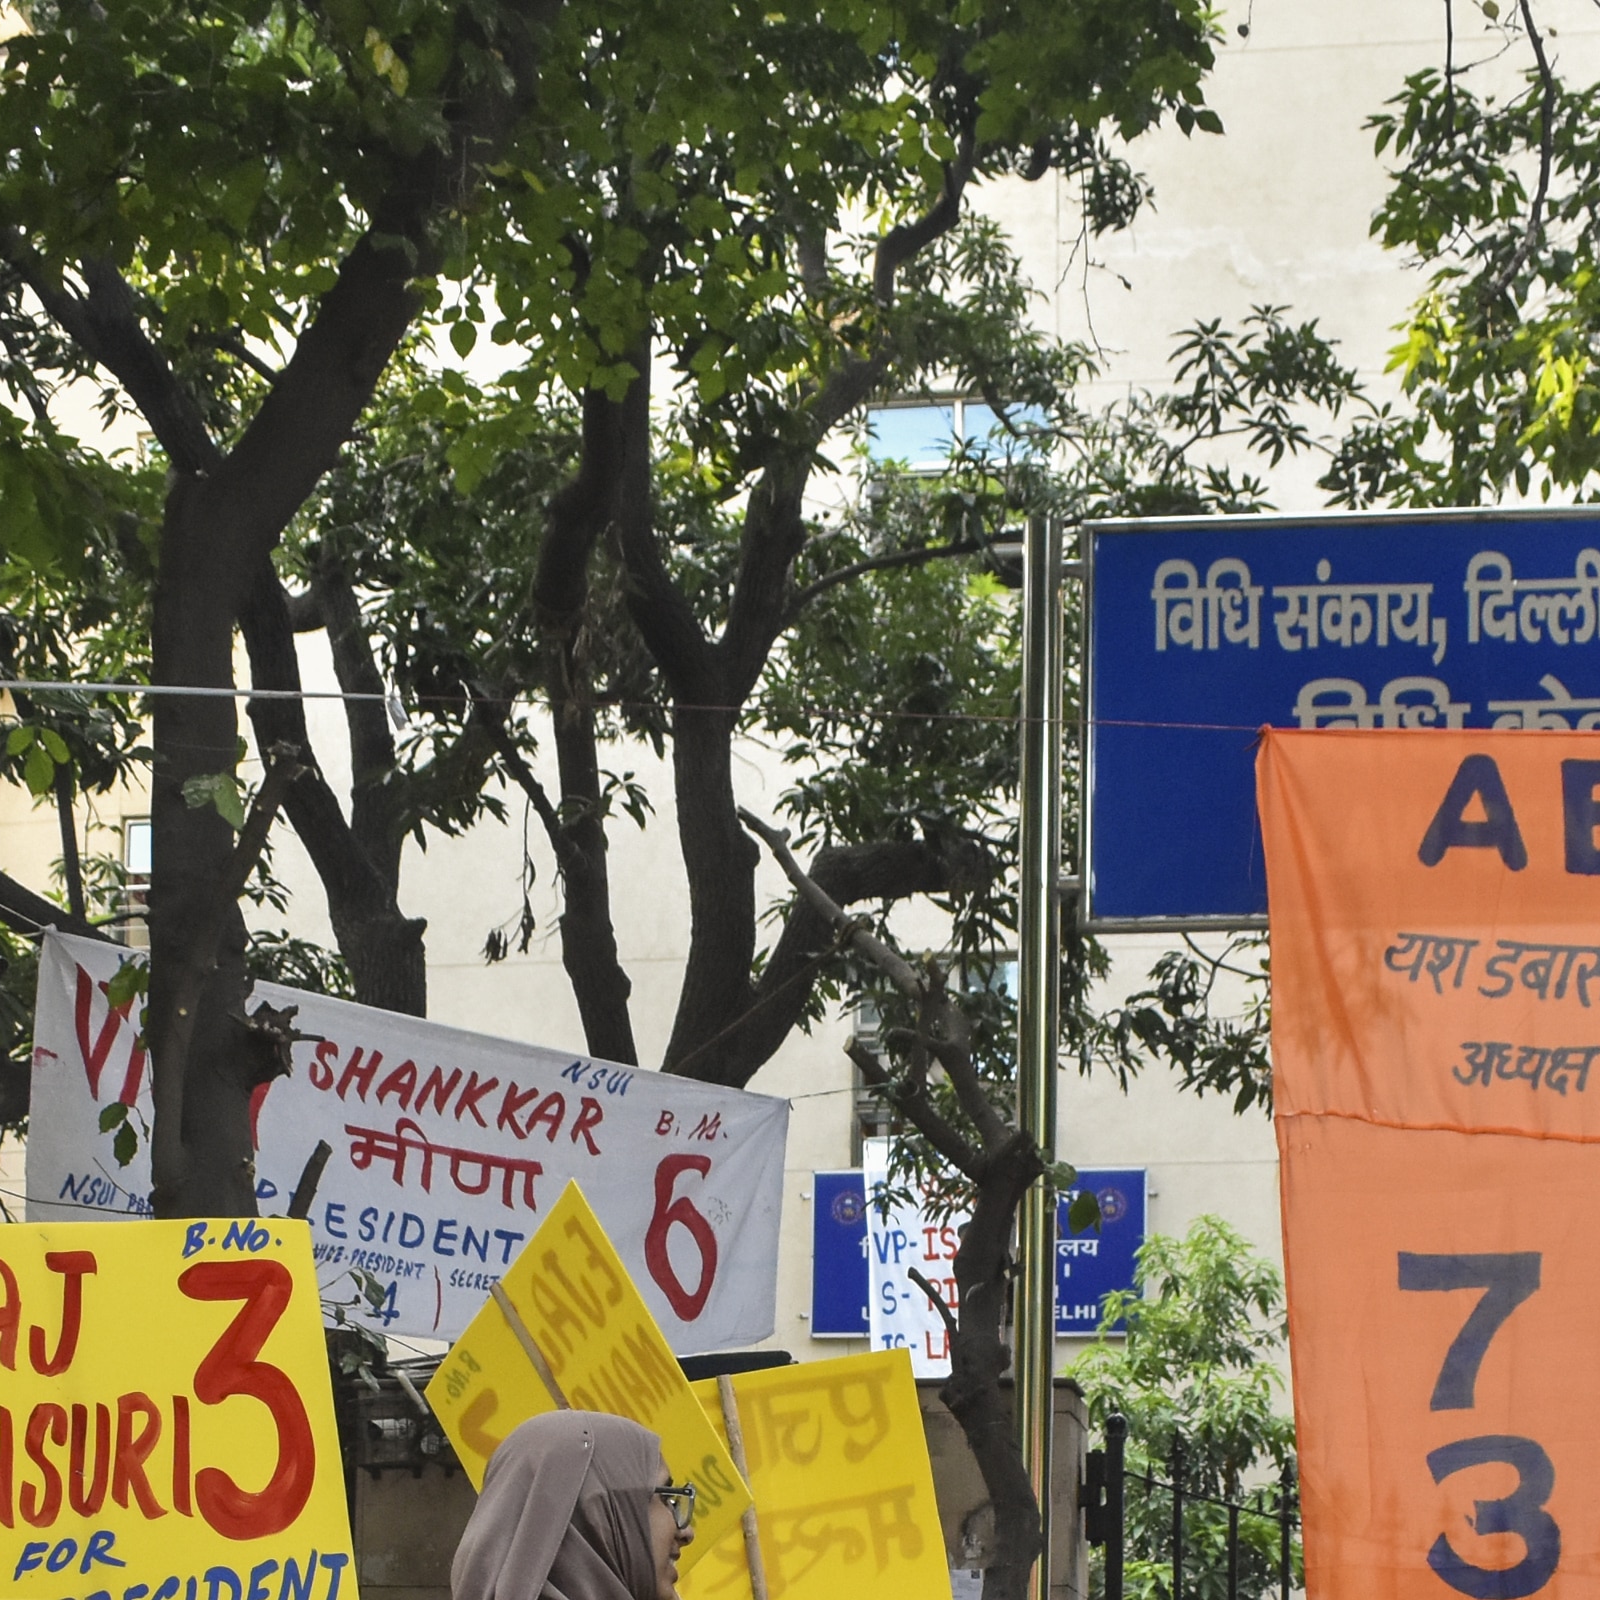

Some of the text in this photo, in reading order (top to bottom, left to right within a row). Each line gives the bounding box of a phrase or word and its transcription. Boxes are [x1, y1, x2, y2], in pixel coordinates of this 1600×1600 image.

[1151, 557, 1262, 655] विधि
[1384, 932, 1479, 994] यश
[308, 1039, 604, 1157] SHANKKAR
[562, 1059, 635, 1098] NSUI
[59, 1172, 117, 1207] NSUI
[344, 1117, 544, 1213] मीणा
[306, 1202, 525, 1265] ESIDENT
[643, 1153, 718, 1323] 6
[1398, 1251, 1542, 1411] 7
[177, 1258, 317, 1541] 3
[13, 1530, 126, 1581] FOR
[1426, 1434, 1561, 1600] 3
